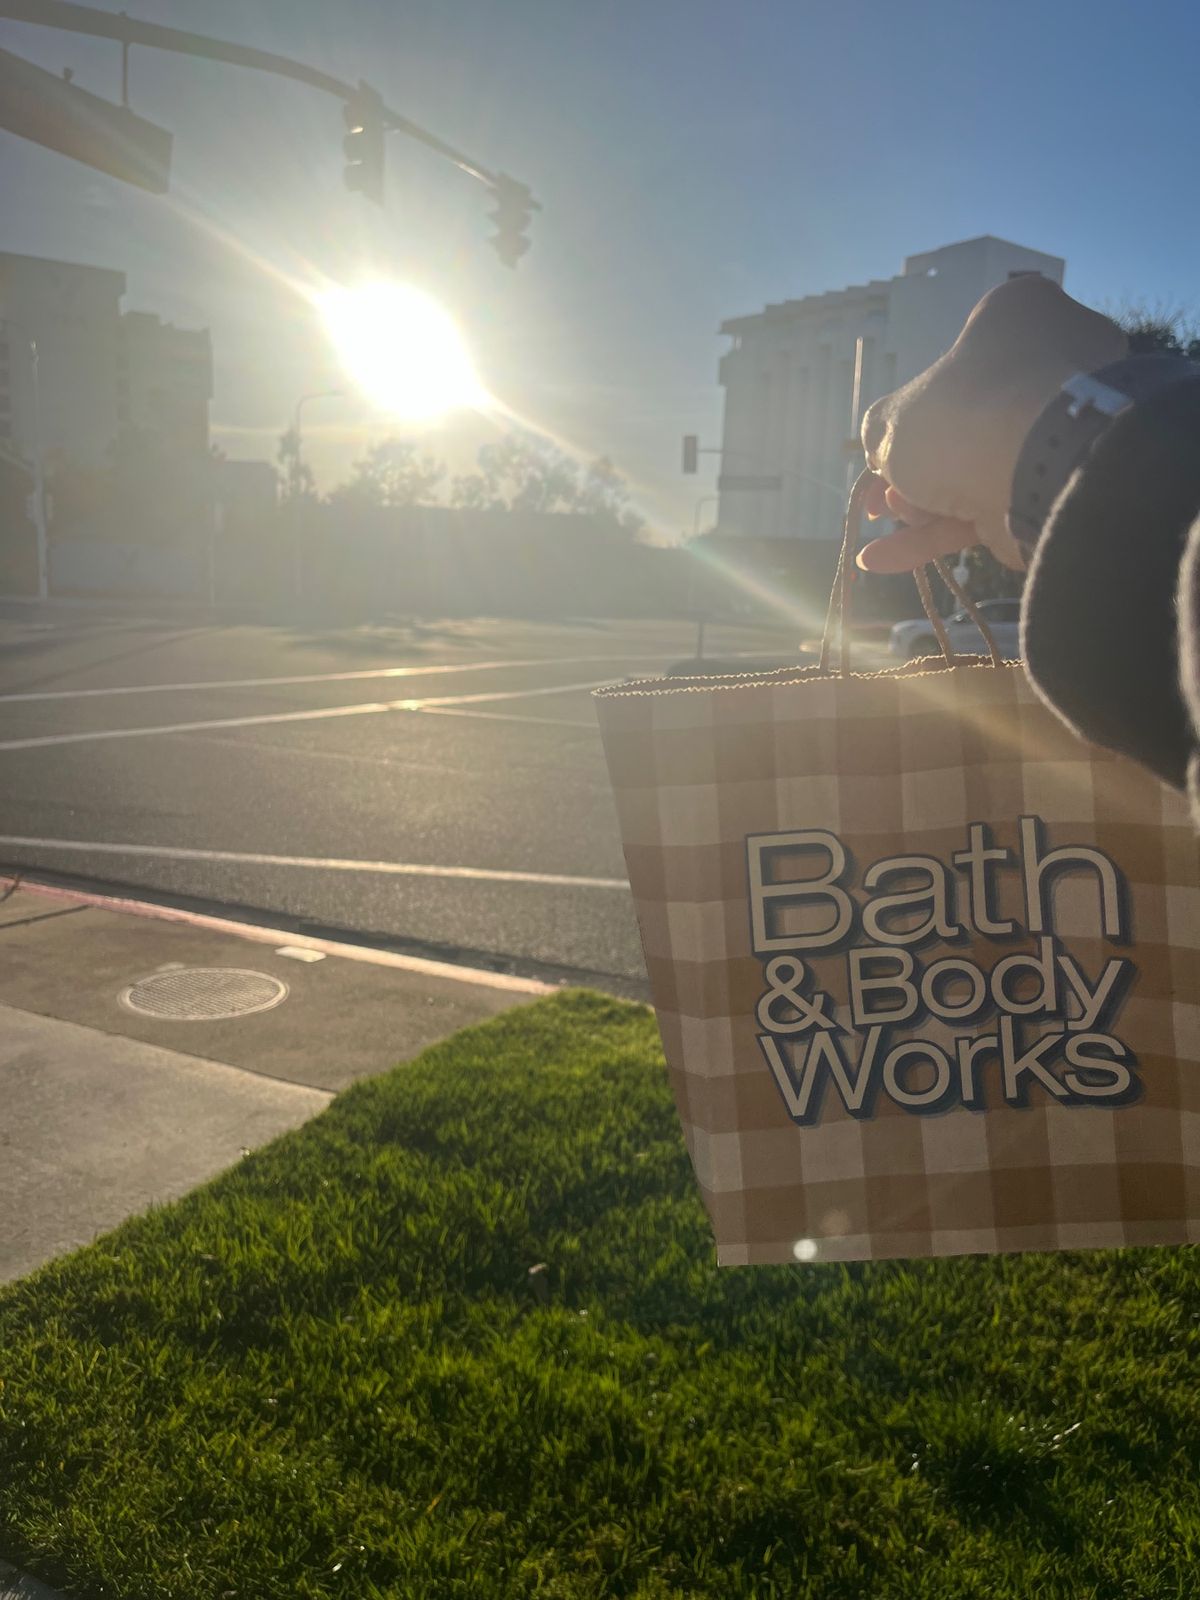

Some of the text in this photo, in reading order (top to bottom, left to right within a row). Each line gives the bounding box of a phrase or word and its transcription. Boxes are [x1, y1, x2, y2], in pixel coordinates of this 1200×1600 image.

[746, 816, 1130, 952] Bath
[756, 936, 1132, 1034] & Body
[757, 1014, 1141, 1124] Works
